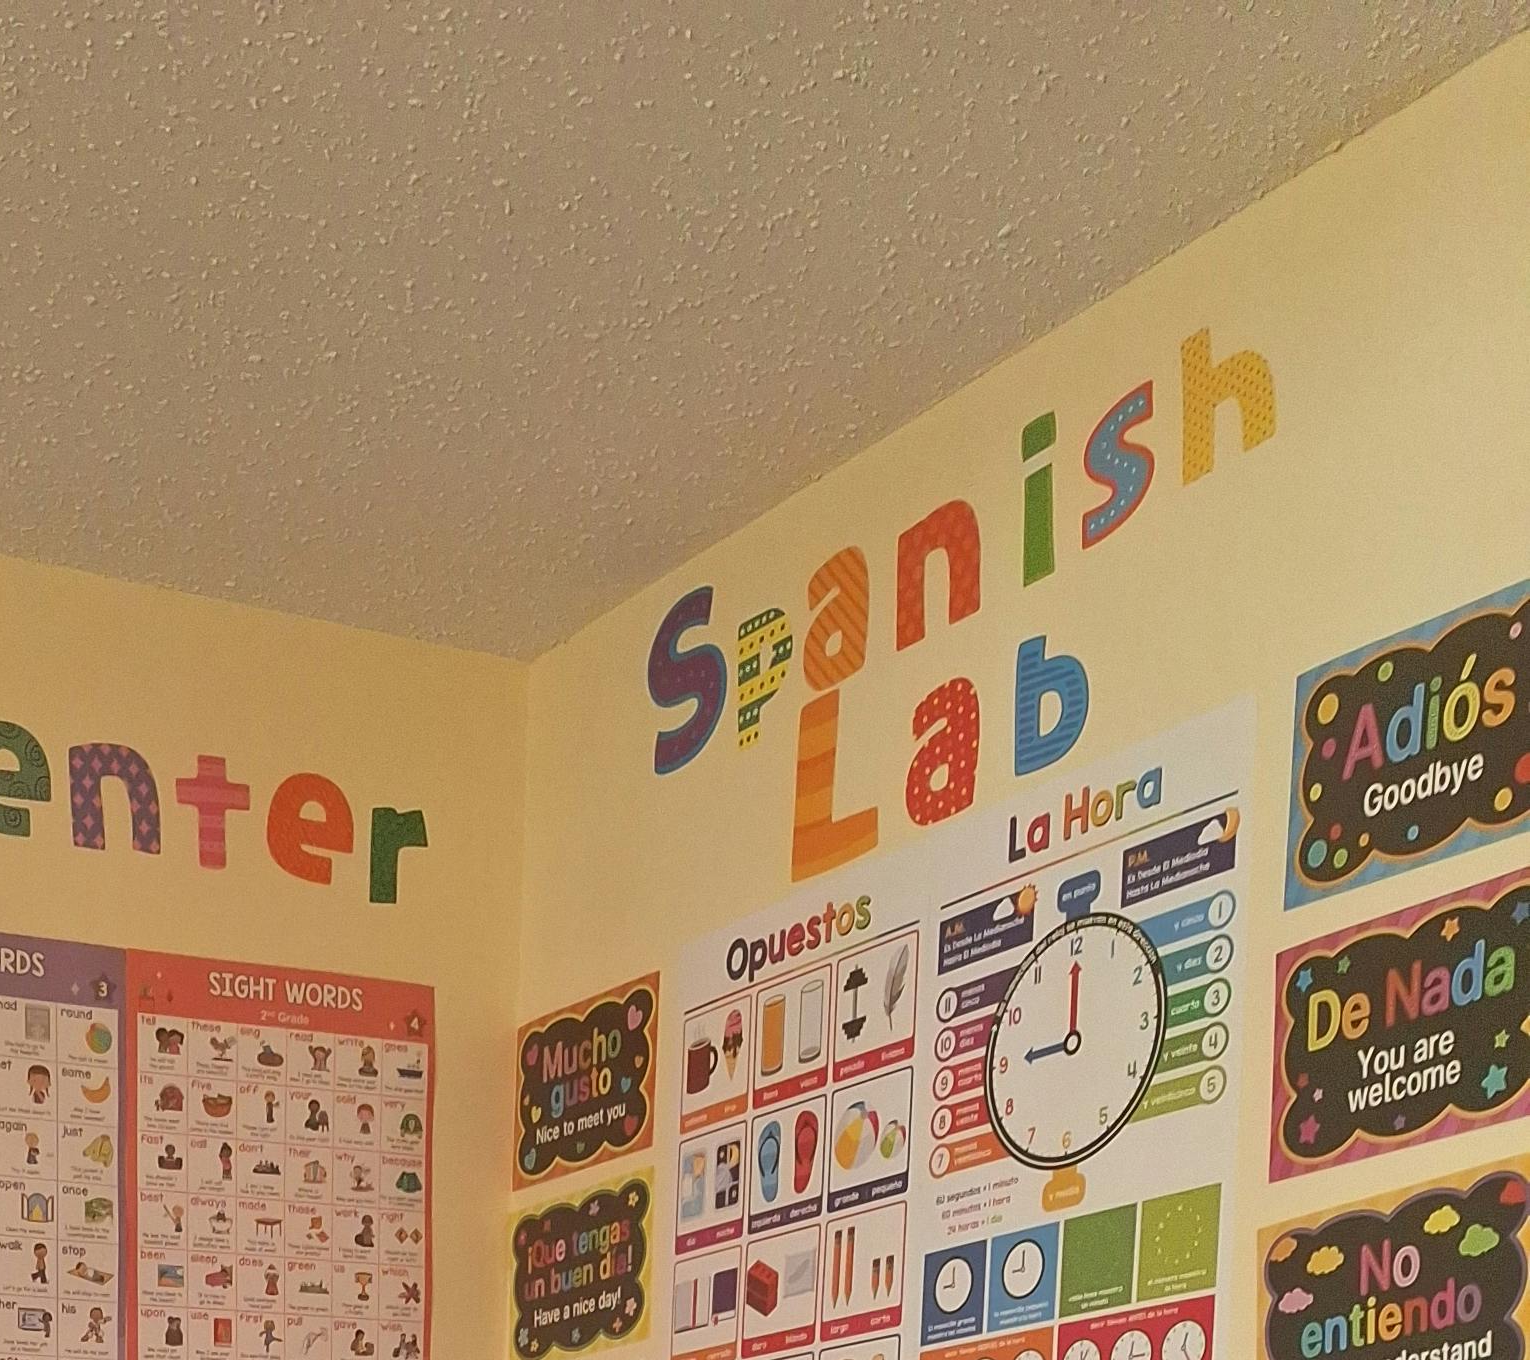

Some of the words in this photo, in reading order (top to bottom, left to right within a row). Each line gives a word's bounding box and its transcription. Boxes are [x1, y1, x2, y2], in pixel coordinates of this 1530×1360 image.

[648, 327, 1277, 775] Spanish
[1342, 654, 1517, 781] Adiós
[791, 636, 1089, 882] Lab
[1364, 750, 1484, 816] Goodbye
[1007, 801, 1052, 862] La
[1063, 765, 1163, 843] Hora
[726, 891, 872, 982] Opuestos
[208, 971, 277, 1001] SIGHT
[285, 980, 363, 1012] WORDS
[1308, 989, 1371, 1052] De
[1384, 939, 1516, 1028] Nada
[542, 1027, 621, 1083] Mucho
[551, 1066, 612, 1119] gusto
[536, 1125, 560, 1145] Nice
[563, 1120, 574, 1136] to
[578, 1108, 604, 1131] meet
[606, 1102, 626, 1126] you
[1360, 1238, 1421, 1297] No
[1301, 1278, 1482, 1358] entiendo
